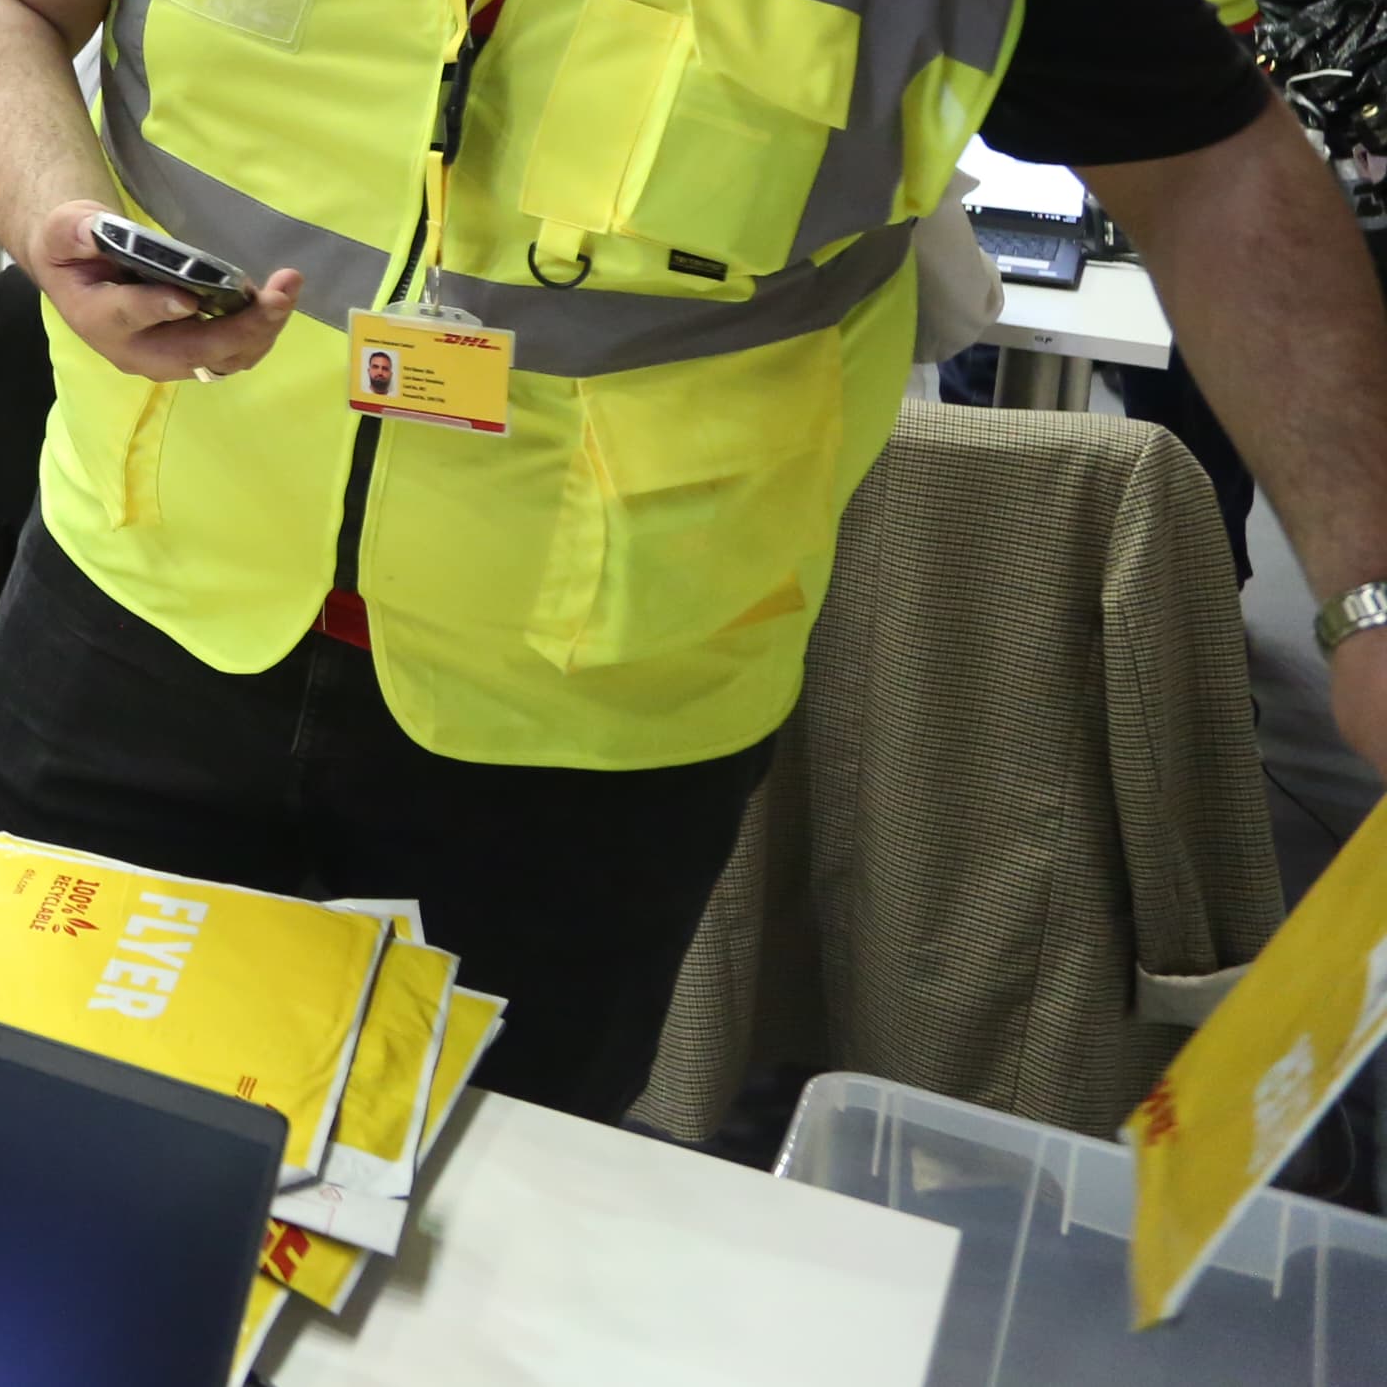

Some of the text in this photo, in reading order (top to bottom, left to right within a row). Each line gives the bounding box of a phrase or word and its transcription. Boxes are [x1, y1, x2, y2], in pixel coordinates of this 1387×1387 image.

[441, 333, 494, 350] DHL
[29, 874, 73, 932] RECYCLABLE
[61, 878, 101, 916] 100%
[87, 891, 210, 1020] FLYER
